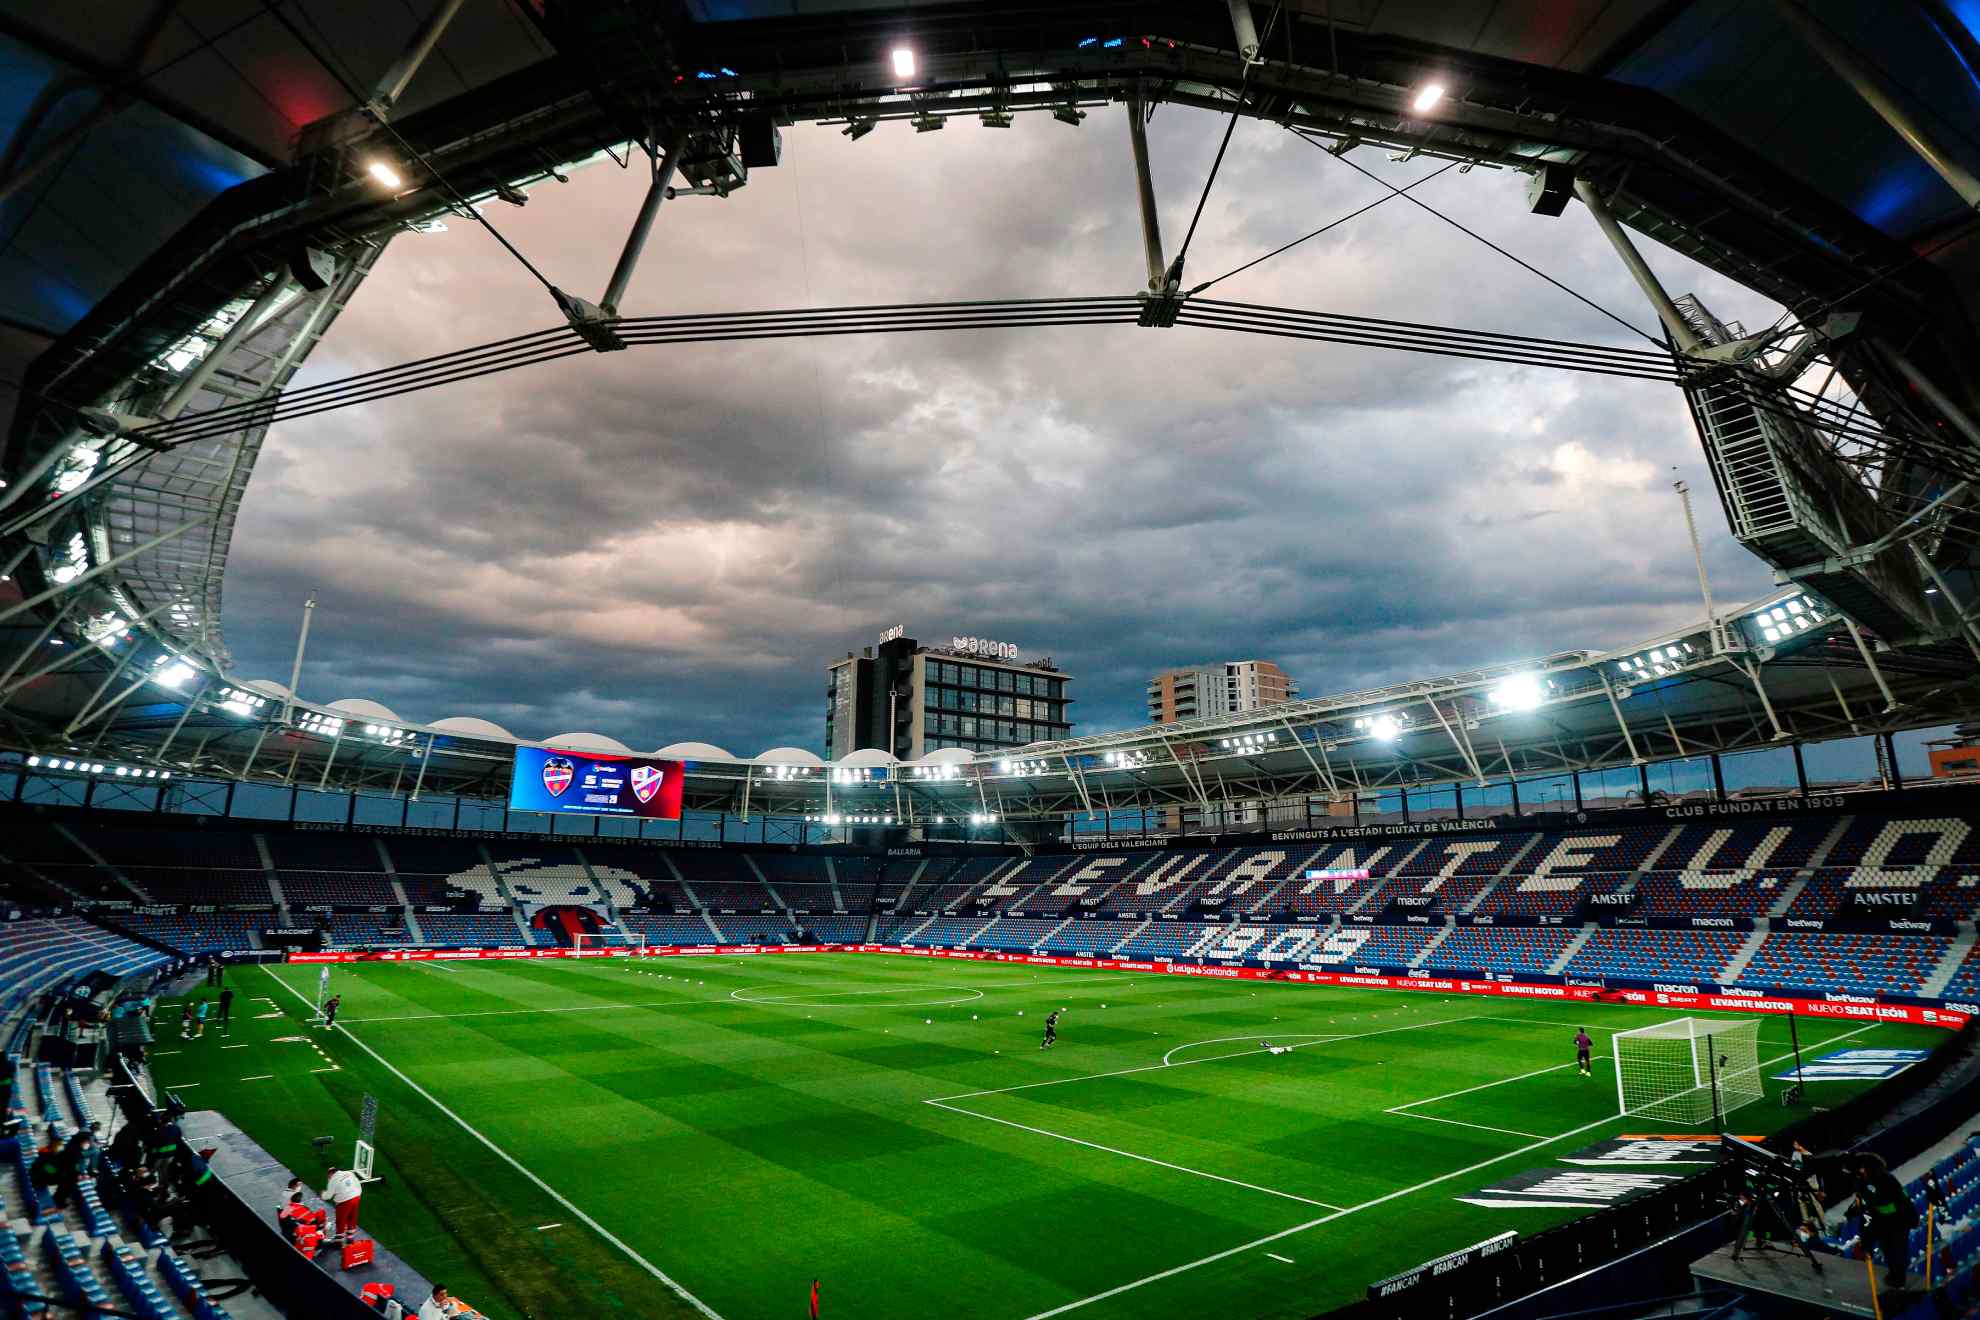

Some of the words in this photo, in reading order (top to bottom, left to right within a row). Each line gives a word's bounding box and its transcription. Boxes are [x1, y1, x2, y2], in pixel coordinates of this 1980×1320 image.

[1665, 805, 1705, 818] CLUB
[1708, 801, 1772, 815] FUNDAT
[1776, 799, 1800, 810] EN
[1806, 796, 1846, 809] 1909
[1272, 830, 1329, 841] BENVINGUTS
[1331, 829, 1338, 838] A
[1340, 827, 1382, 838] L'ESTADI
[1386, 824, 1421, 835] CIUTAT
[1423, 822, 1438, 832] DE
[1101, 841, 1119, 849] DELS
[1121, 838, 1168, 848] VALENCIANS
[983, 834, 1622, 896] LEVANTE
[1200, 897, 1227, 906] macro
[1353, 914, 1374, 923] betway
[1407, 914, 1430, 924] betway
[1691, 917, 1734, 928] macron
[1787, 919, 1824, 930] betway
[1889, 919, 1932, 932] betway
[1182, 925, 1373, 963] 1909
[1154, 956, 1174, 964] betway
[1173, 964, 1195, 974] LaLiga
[1201, 966, 1239, 976] Santander
[1299, 963, 1322, 972] betway
[1355, 966, 1380, 976] betway
[1340, 976, 1364, 984] LEVANTE
[1364, 977, 1389, 985] MOTOR
[1397, 979, 1417, 987] NUEVO
[1417, 980, 1434, 988] SEAT
[1434, 980, 1453, 989] LEÓN
[1501, 985, 1535, 994] LEVANTE
[1535, 987, 1565, 996] MOTOR
[1653, 983, 1699, 994] macron
[1720, 986, 1764, 997] betway
[1825, 992, 1876, 1004] betway
[1710, 997, 1755, 1008] LEVANTE
[1754, 1000, 1794, 1011] MOTOR
[1807, 1003, 1843, 1014] NUEVO
[1844, 1005, 1874, 1016] SEAT
[1875, 1006, 1908, 1019] LEÓN
[1480, 1235, 1513, 1258] #FANCAM
[1432, 1253, 1469, 1277] #FANCAM
[1380, 1274, 1420, 1297] #FANCAM
